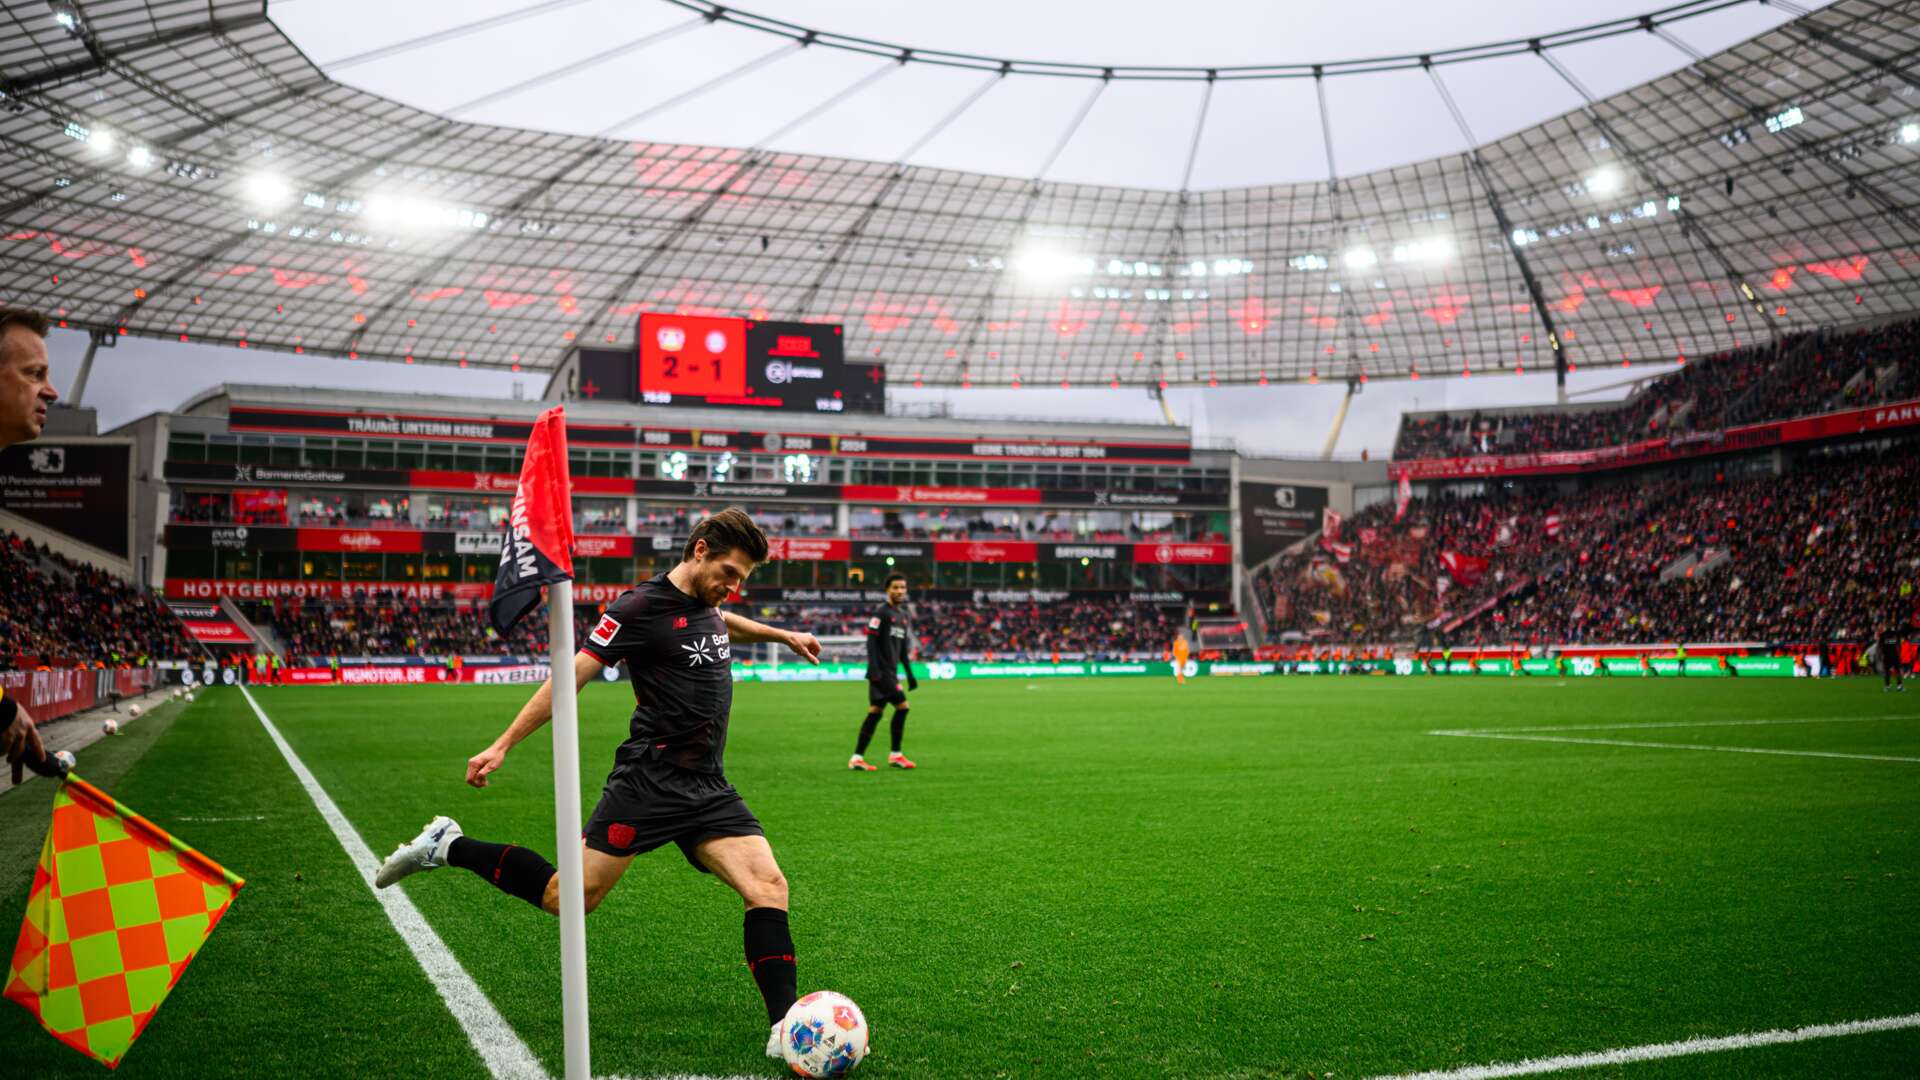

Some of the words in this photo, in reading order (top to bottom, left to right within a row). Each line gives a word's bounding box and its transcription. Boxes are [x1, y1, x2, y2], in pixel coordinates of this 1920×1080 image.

[662, 355, 679, 378] 2
[711, 359, 722, 381] 1
[402, 420, 452, 435] UNTERM
[453, 424, 493, 438] KREUZ
[784, 437, 813, 450] 2024
[839, 439, 868, 452] 2024
[342, 667, 426, 683] MGMOTOR.DE
